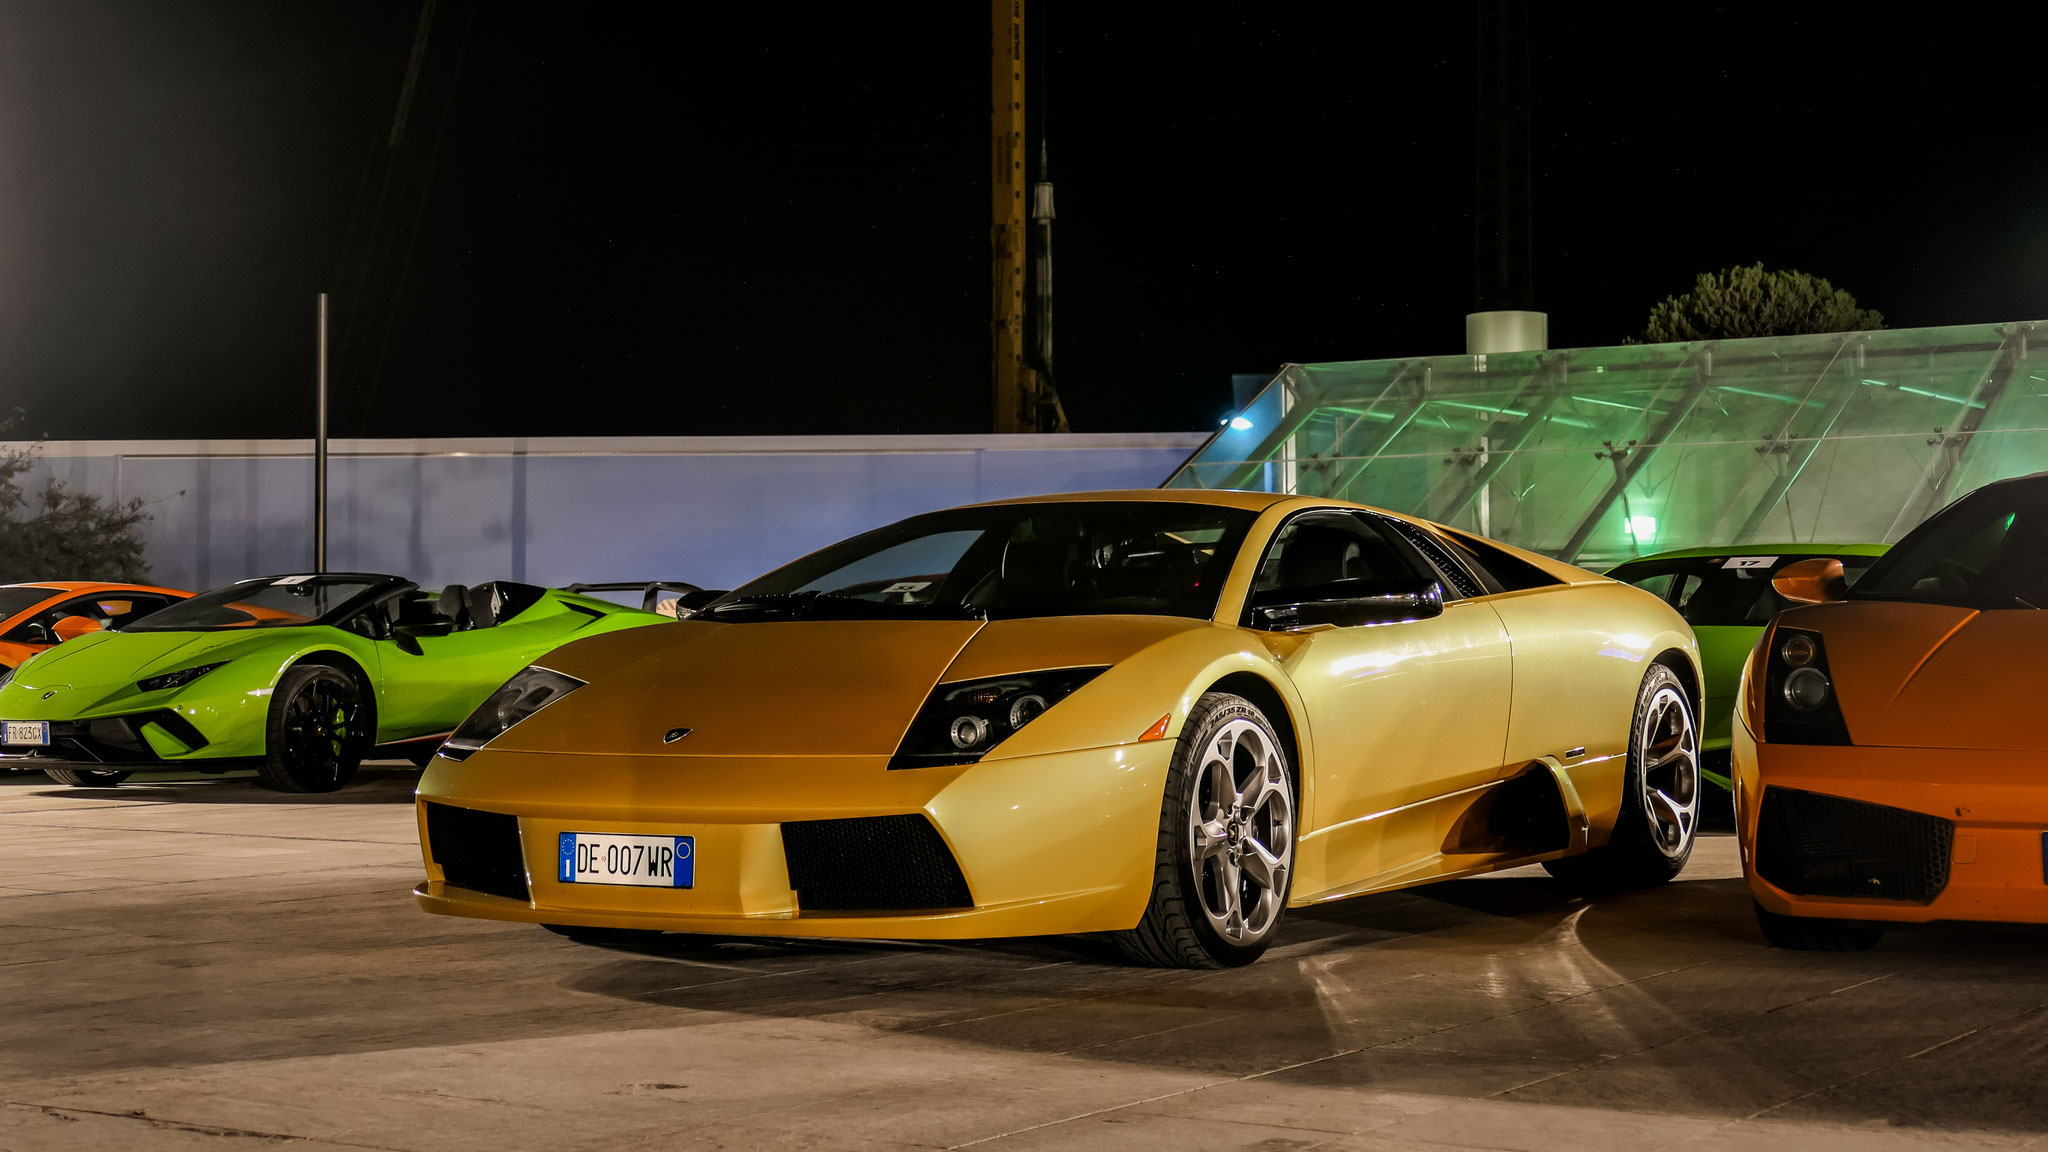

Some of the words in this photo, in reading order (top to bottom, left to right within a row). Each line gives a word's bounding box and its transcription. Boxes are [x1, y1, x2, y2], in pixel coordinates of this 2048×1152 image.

[1210, 706, 1236, 729] 245/35
[1236, 706, 1247, 714] ZR
[8, 726, 17, 740] FR
[577, 843, 600, 874] DE
